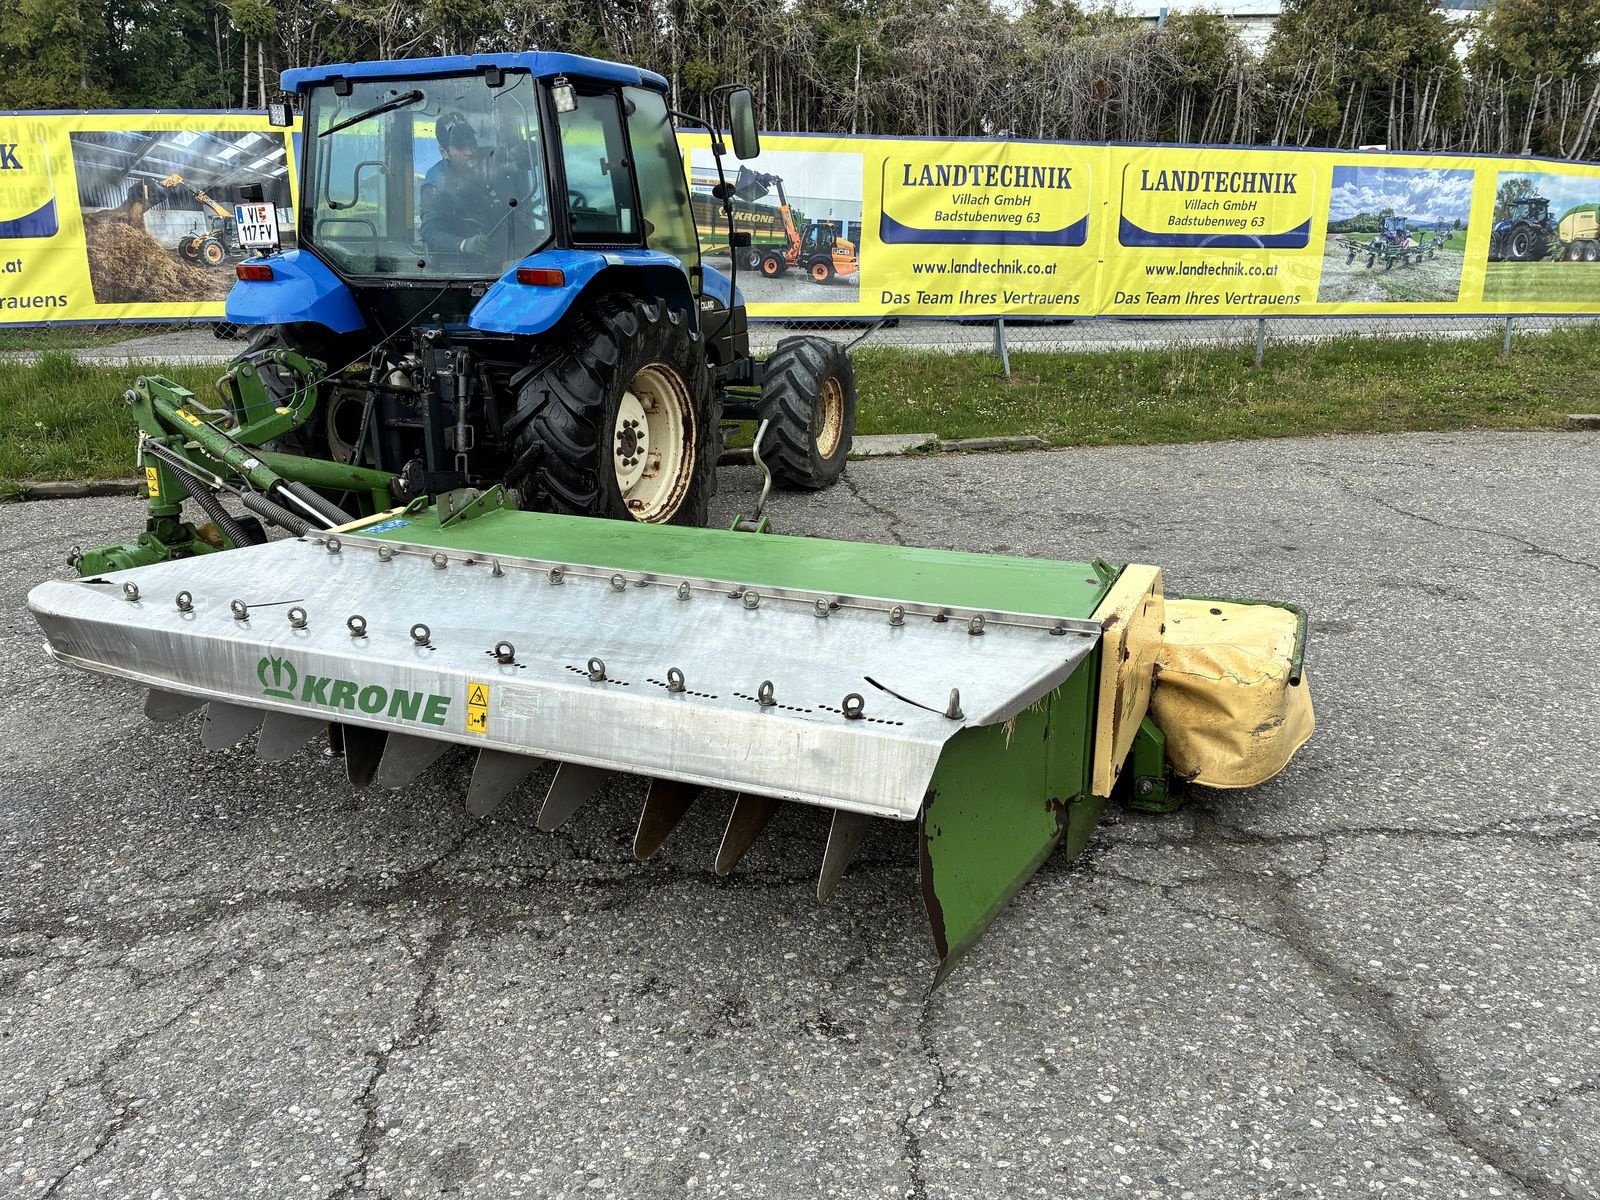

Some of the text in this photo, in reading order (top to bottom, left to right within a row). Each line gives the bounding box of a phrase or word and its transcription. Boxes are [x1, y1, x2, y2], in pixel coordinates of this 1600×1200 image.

[902, 163, 1072, 189] LANDTECHNIK
[1140, 169, 1298, 194] LANDTECHNIK
[952, 194, 1031, 206] Villach GmbH
[1184, 200, 1257, 211] Villach GmbH
[734, 211, 775, 224] KRONE
[934, 211, 1041, 225] Badstubenweg 63
[1168, 216, 1265, 229] Badstubenweg 63
[242, 224, 272, 241] 117 FV
[912, 258, 1058, 275] www.landtechnik.co.at
[1145, 261, 1279, 276] www.landtechnik.co.at
[881, 290, 1080, 304] Das Team Ihres Vertrauens
[1114, 291, 1301, 305] Das Team Ihres Vertrauens
[301, 674, 452, 726] KRONE
